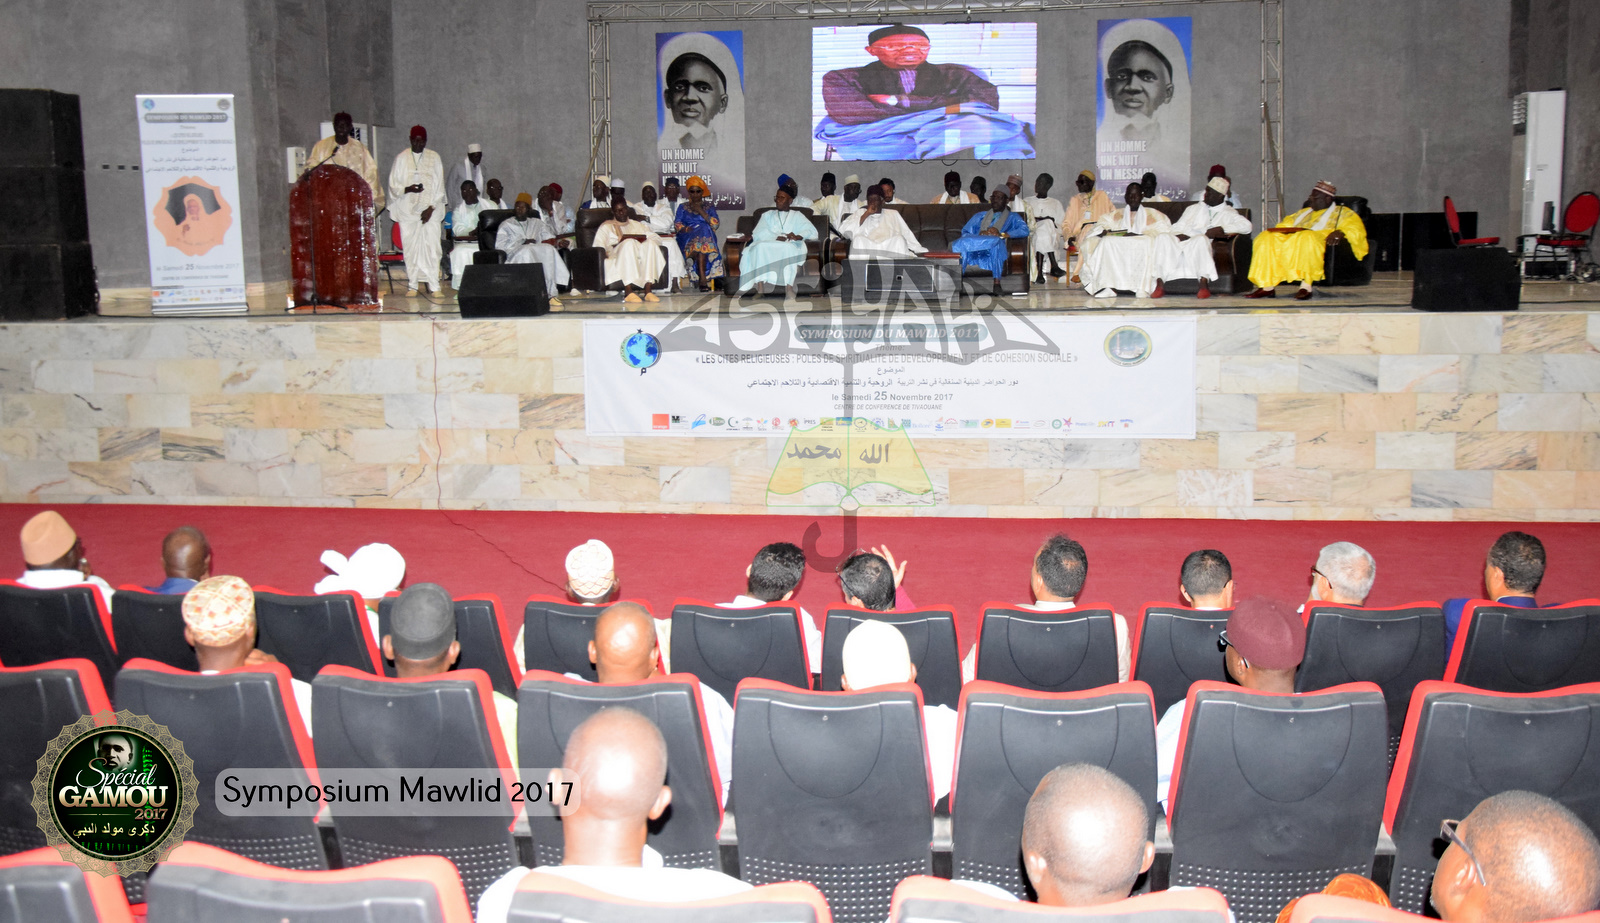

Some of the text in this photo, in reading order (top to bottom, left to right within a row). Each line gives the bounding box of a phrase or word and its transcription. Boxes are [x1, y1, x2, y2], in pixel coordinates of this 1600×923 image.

[1100, 140, 1147, 152] UN HOMME
[661, 148, 704, 160] UN HOMME
[1101, 154, 1139, 166] UNE NUIT
[662, 162, 697, 174] UNE NUIT
[1100, 168, 1113, 180] UN
[185, 263, 194, 271] 25
[800, 328, 981, 340] SYMPOSIUM DU MAWLID 2017
[701, 354, 716, 364] LES
[717, 354, 739, 364] CITES
[741, 354, 790, 364] RELIGIEUSES
[796, 354, 822, 364] POLES
[824, 354, 834, 364] DE
[836, 354, 887, 363] SPIRITUALITE
[888, 353, 898, 363] DE
[898, 353, 969, 363] DEVELOPPEMENT
[970, 353, 980, 363] ET
[982, 353, 993, 363] DE
[995, 353, 1035, 363] COHESION
[1037, 352, 1072, 363] SOCIALE
[831, 391, 954, 401] le Samedi 25 Novembre 2017
